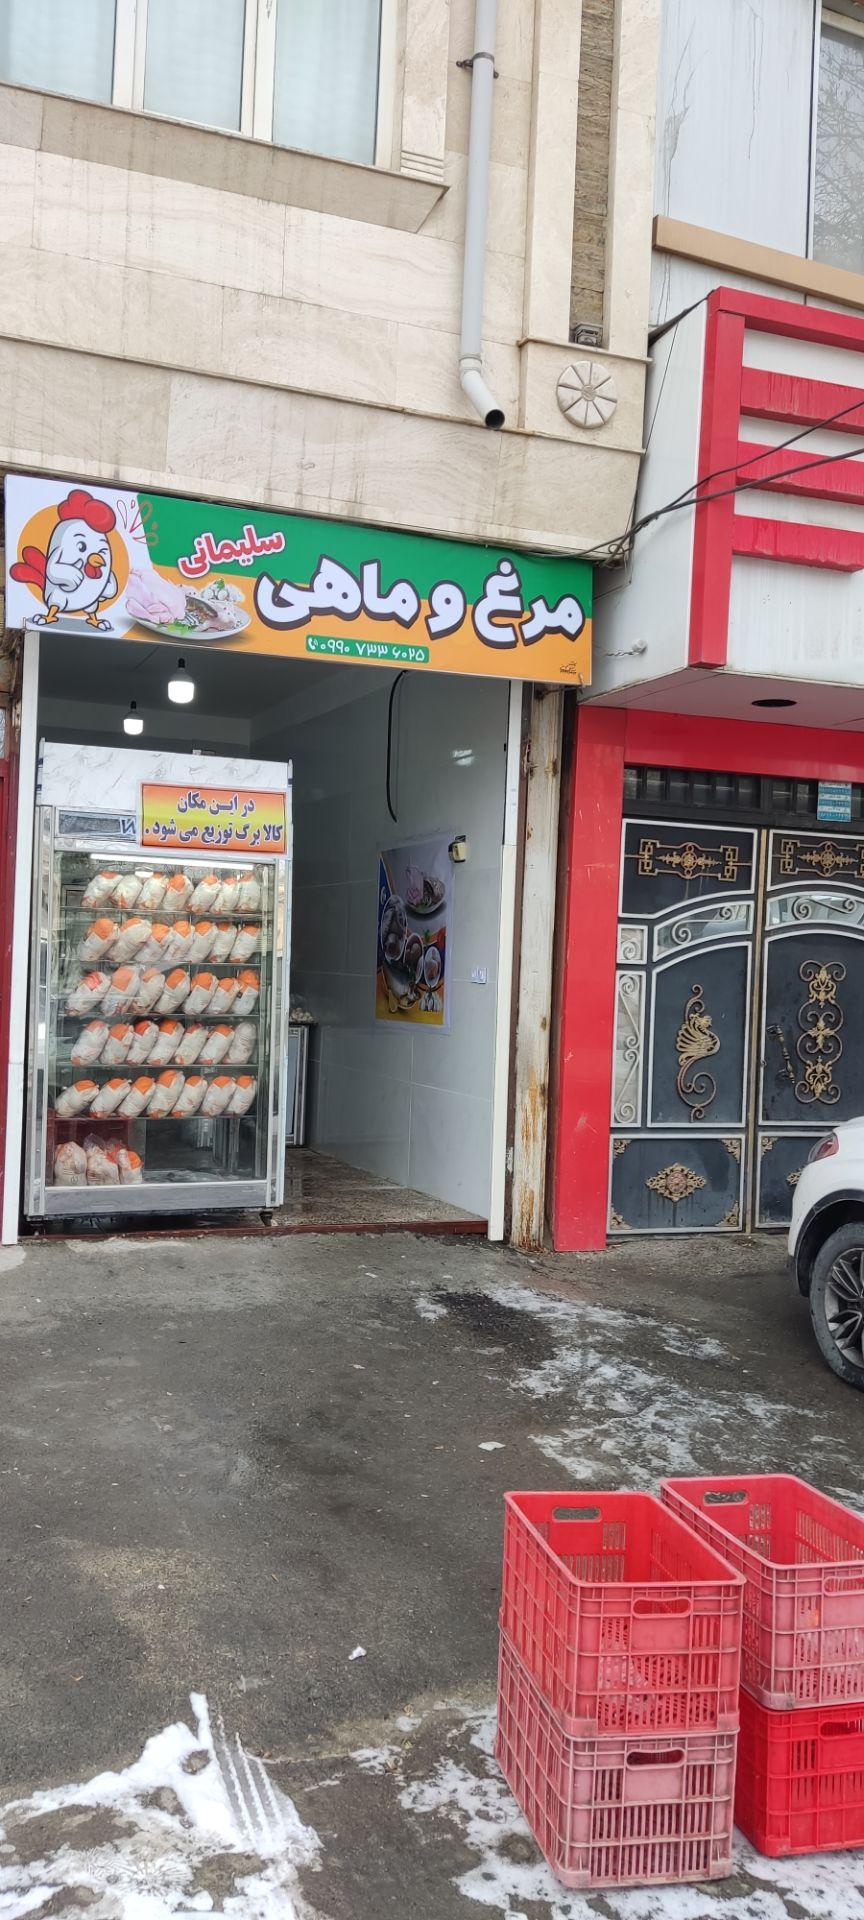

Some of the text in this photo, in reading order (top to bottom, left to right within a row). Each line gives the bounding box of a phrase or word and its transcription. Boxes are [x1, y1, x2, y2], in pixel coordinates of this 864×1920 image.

[178, 525, 285, 577] سلیمانی
[254, 554, 585, 649] مرغ و ماهی
[320, 640, 425, 661] ۰۹۹۰ ۷۳۳ ۶۰۲۵
[177, 791, 255, 818] در این مکان
[179, 825, 199, 842] می
[201, 822, 233, 845] توزیع
